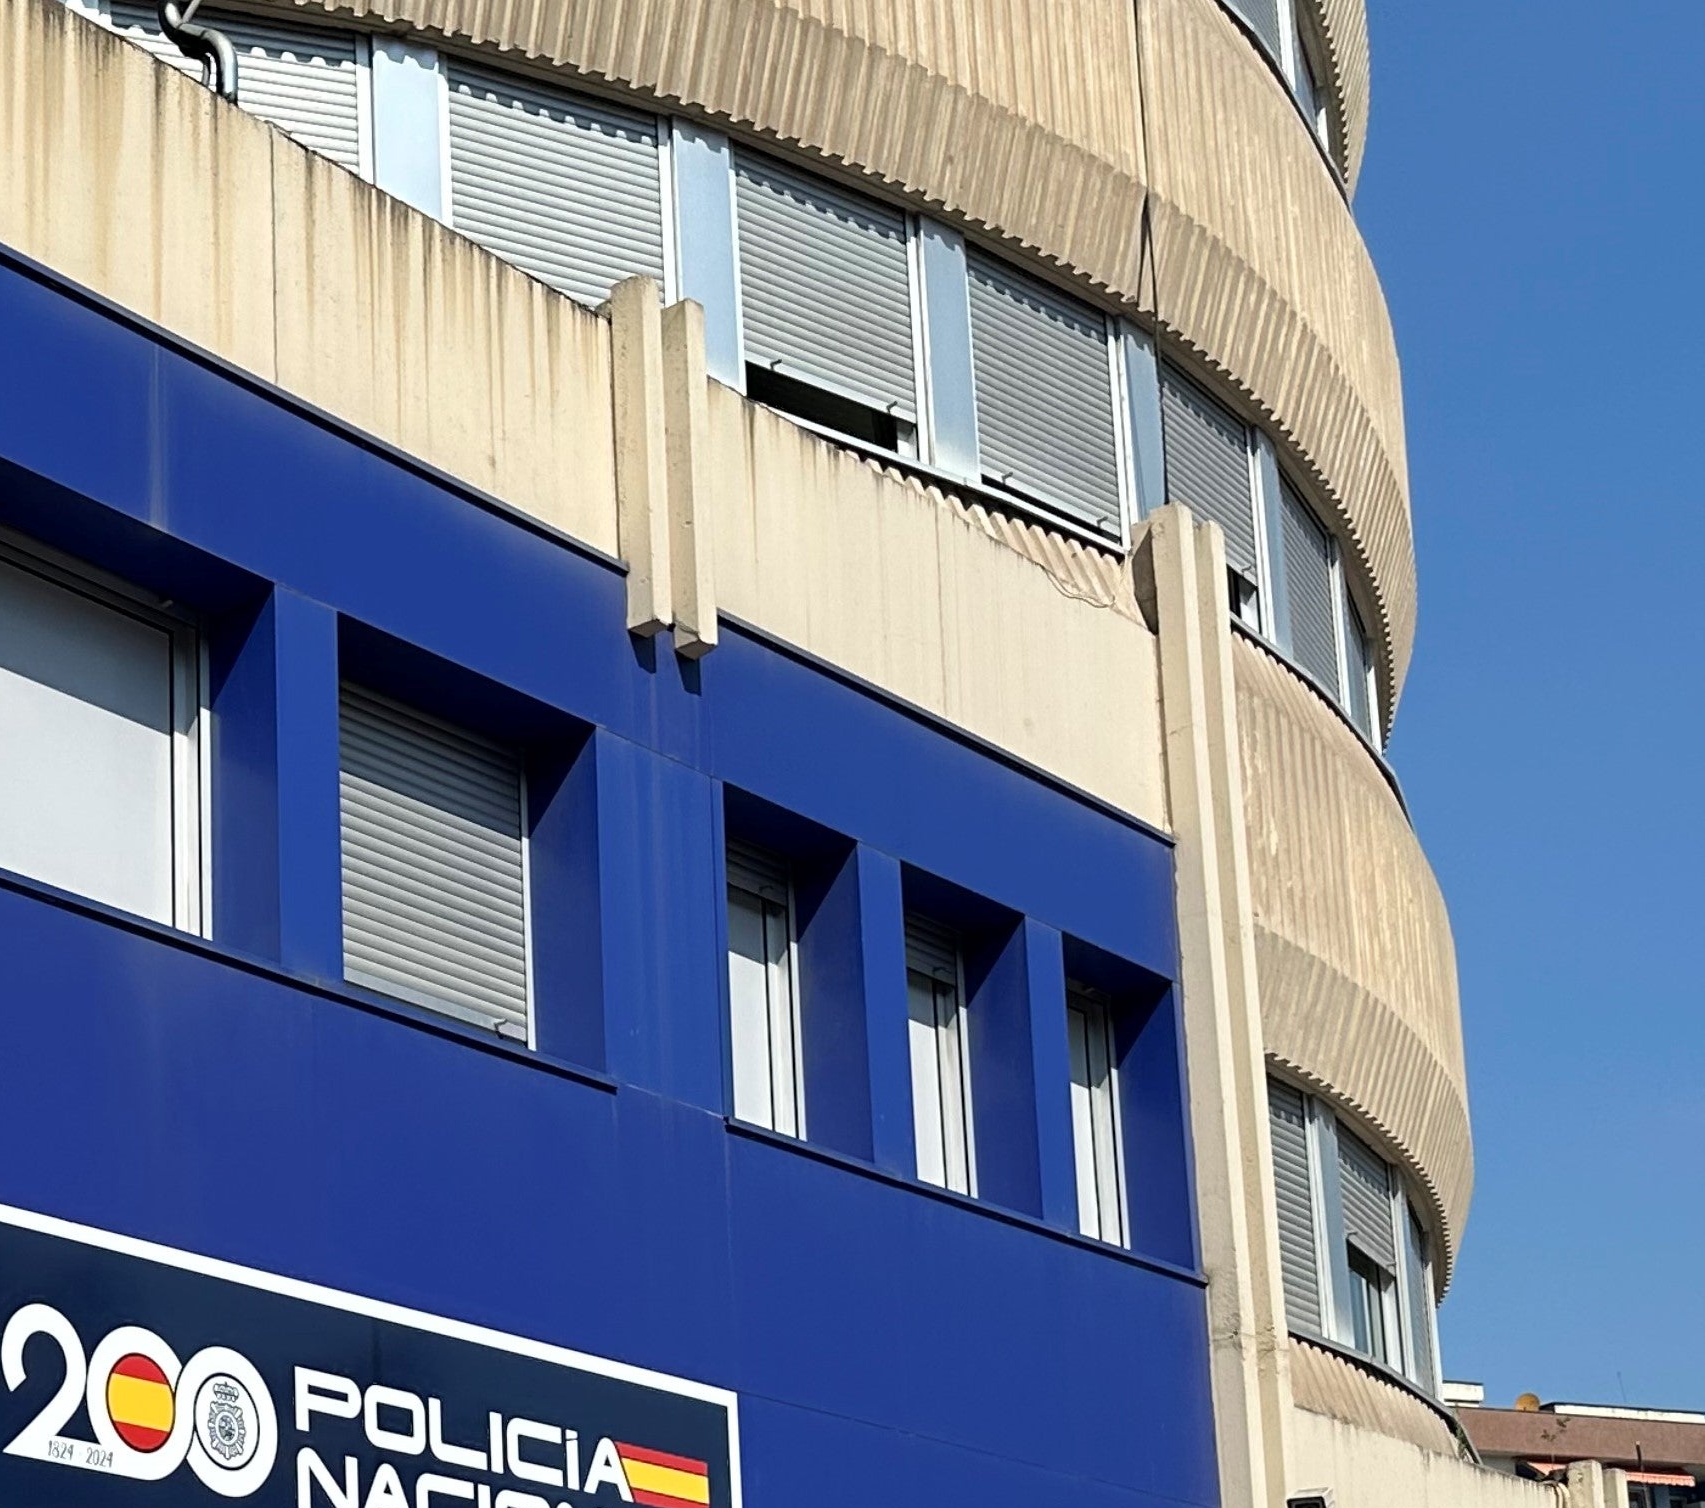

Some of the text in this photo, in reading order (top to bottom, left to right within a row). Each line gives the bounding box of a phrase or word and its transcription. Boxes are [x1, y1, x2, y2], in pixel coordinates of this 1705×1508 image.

[1, 1303, 278, 1497] 200
[48, 1440, 113, 1468] 1824 2024
